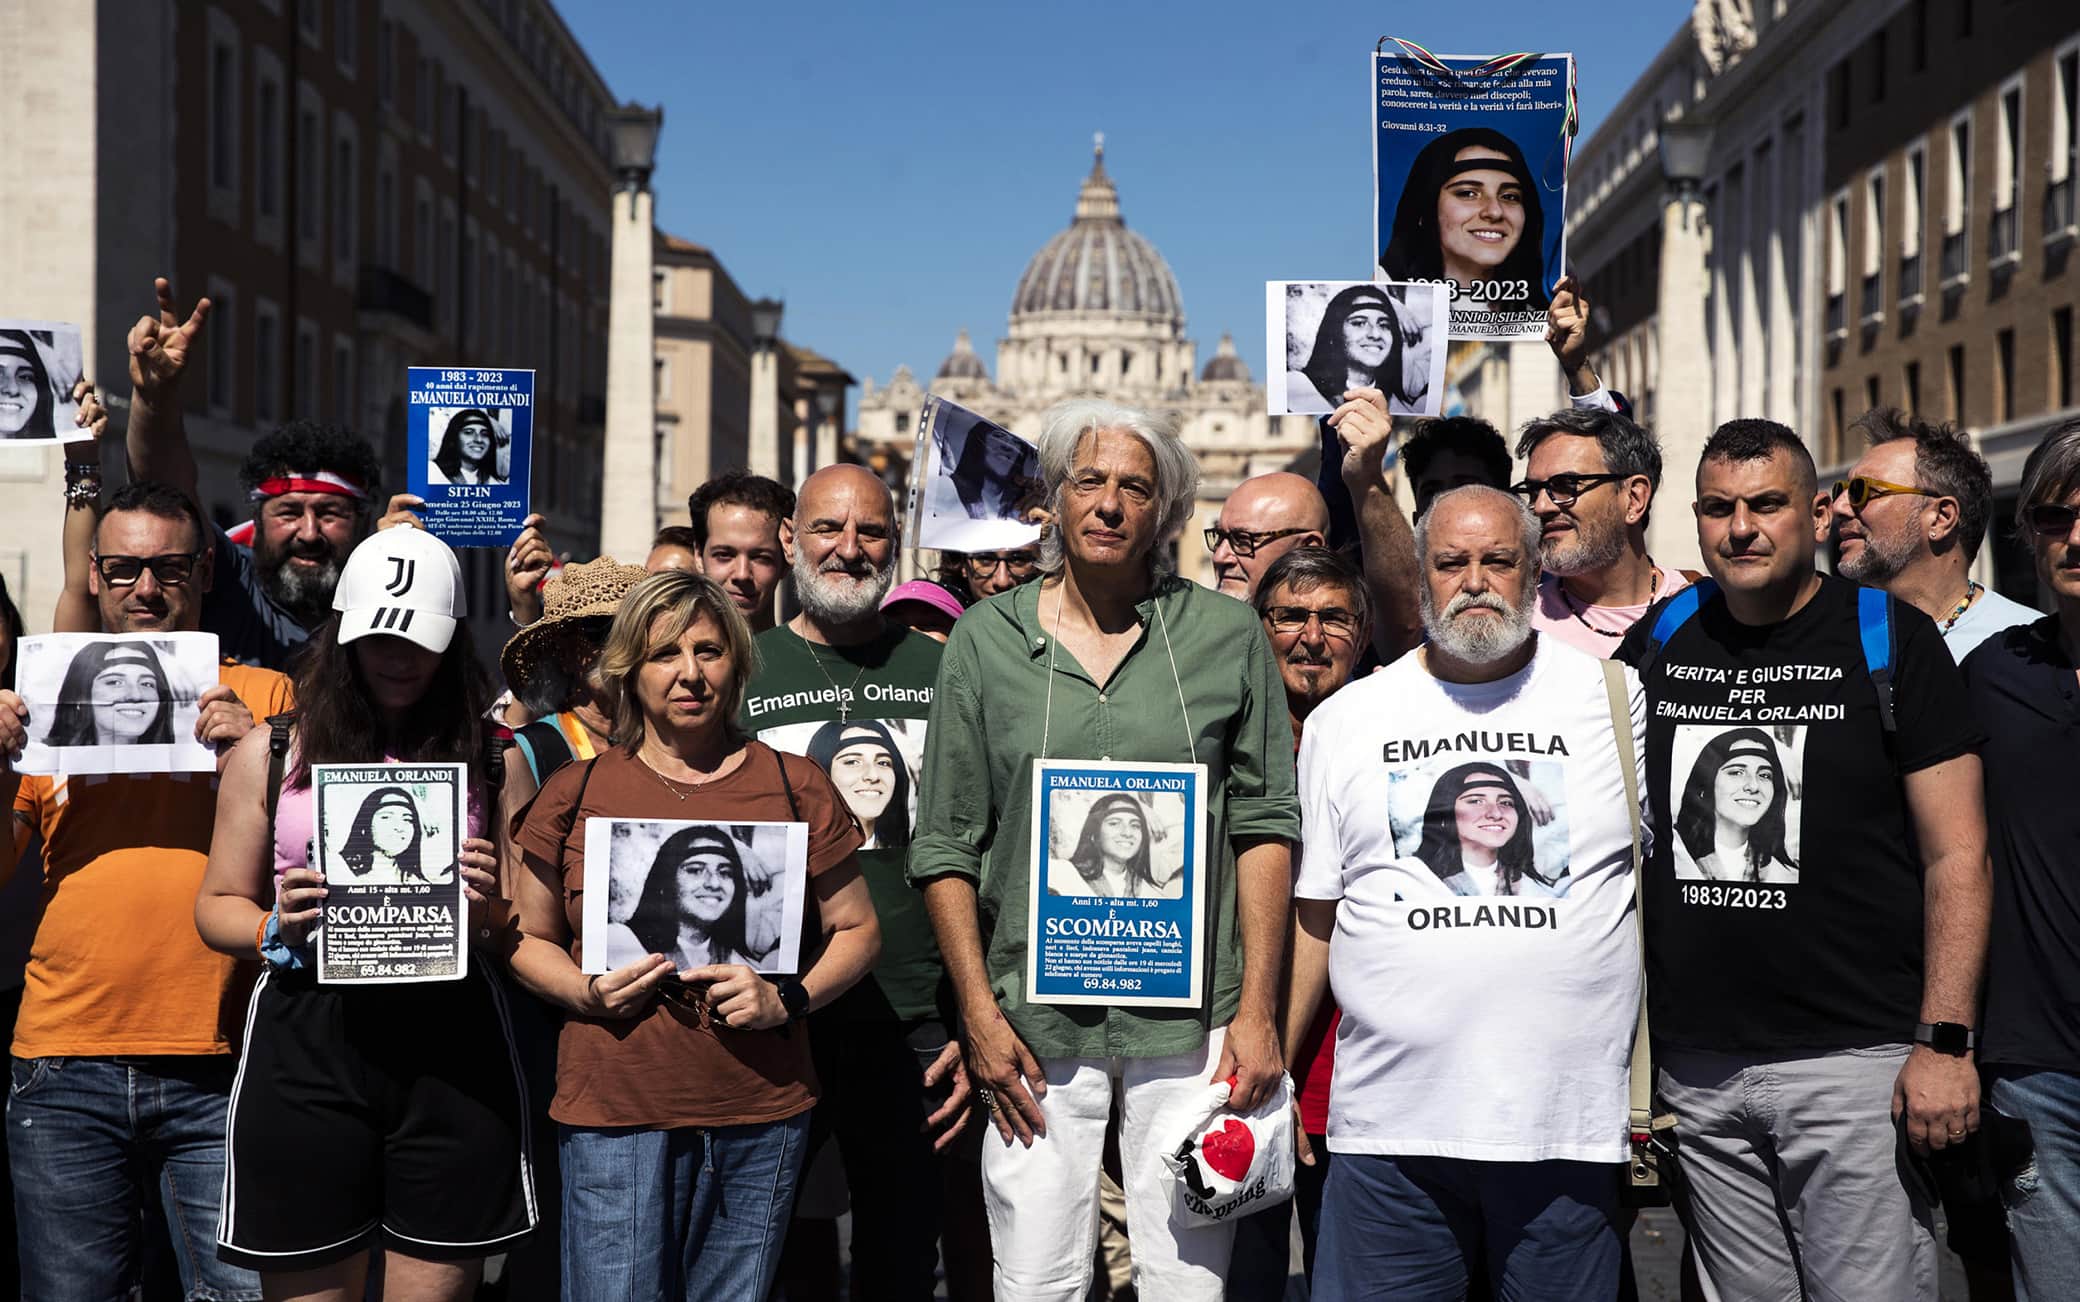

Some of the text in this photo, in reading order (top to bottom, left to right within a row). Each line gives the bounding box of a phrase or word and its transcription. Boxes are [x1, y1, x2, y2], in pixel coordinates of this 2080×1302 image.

[1381, 78, 1412, 86] creduto
[1518, 79, 1533, 87] alla
[1535, 78, 1551, 87] mia
[1381, 88, 1409, 97] parola,
[1410, 90, 1433, 98] sarete
[1490, 90, 1532, 101] discepoli;
[1381, 100, 1429, 109] conoscerete
[1429, 101, 1437, 109] la
[1439, 101, 1462, 110] verità
[1470, 102, 1478, 110] la
[1480, 102, 1504, 110] verità
[1506, 102, 1514, 110] vi
[1516, 101, 1533, 110] farà
[1382, 120, 1417, 131] Giovanni
[1481, 310, 1497, 322] DI
[1497, 310, 1549, 322] SILENZI
[1500, 324, 1544, 334] ORLANDI
[441, 371, 466, 382] 1983
[476, 372, 503, 383] 2023
[425, 382, 518, 392] 40 anni dal rapimento di
[411, 391, 530, 407] EMANUELA ORLANDI
[448, 486, 491, 497] SIT-IN
[460, 500, 470, 508] 25
[472, 500, 501, 510] Giugno
[503, 500, 520, 508] 2023
[1665, 663, 1843, 684] VERITA' E GIUSTIZIA
[747, 684, 934, 717] Emanuela Orlandi
[1728, 689, 1766, 704] PER
[1656, 701, 1845, 721] EMANUELA ORLANDI
[1383, 730, 1570, 763] EMANUELA
[324, 770, 453, 782] EMANUELA ORLANDI
[1050, 775, 1186, 790] EMANUELA ORLANDI
[368, 886, 378, 894] 15
[1072, 897, 1091, 906] Anni
[1094, 898, 1103, 906] 15
[1110, 898, 1124, 907] alta
[1126, 899, 1139, 907] mt.
[1142, 899, 1159, 908] 1,60
[1681, 884, 1787, 909] 1983/2023
[327, 905, 454, 925] SCOMPARSA
[1407, 905, 1557, 931] ORLANDI
[1046, 917, 1183, 939] SCOMPARSA
[360, 963, 416, 977] 69.84.982
[1083, 978, 1142, 990] 69.84.982
